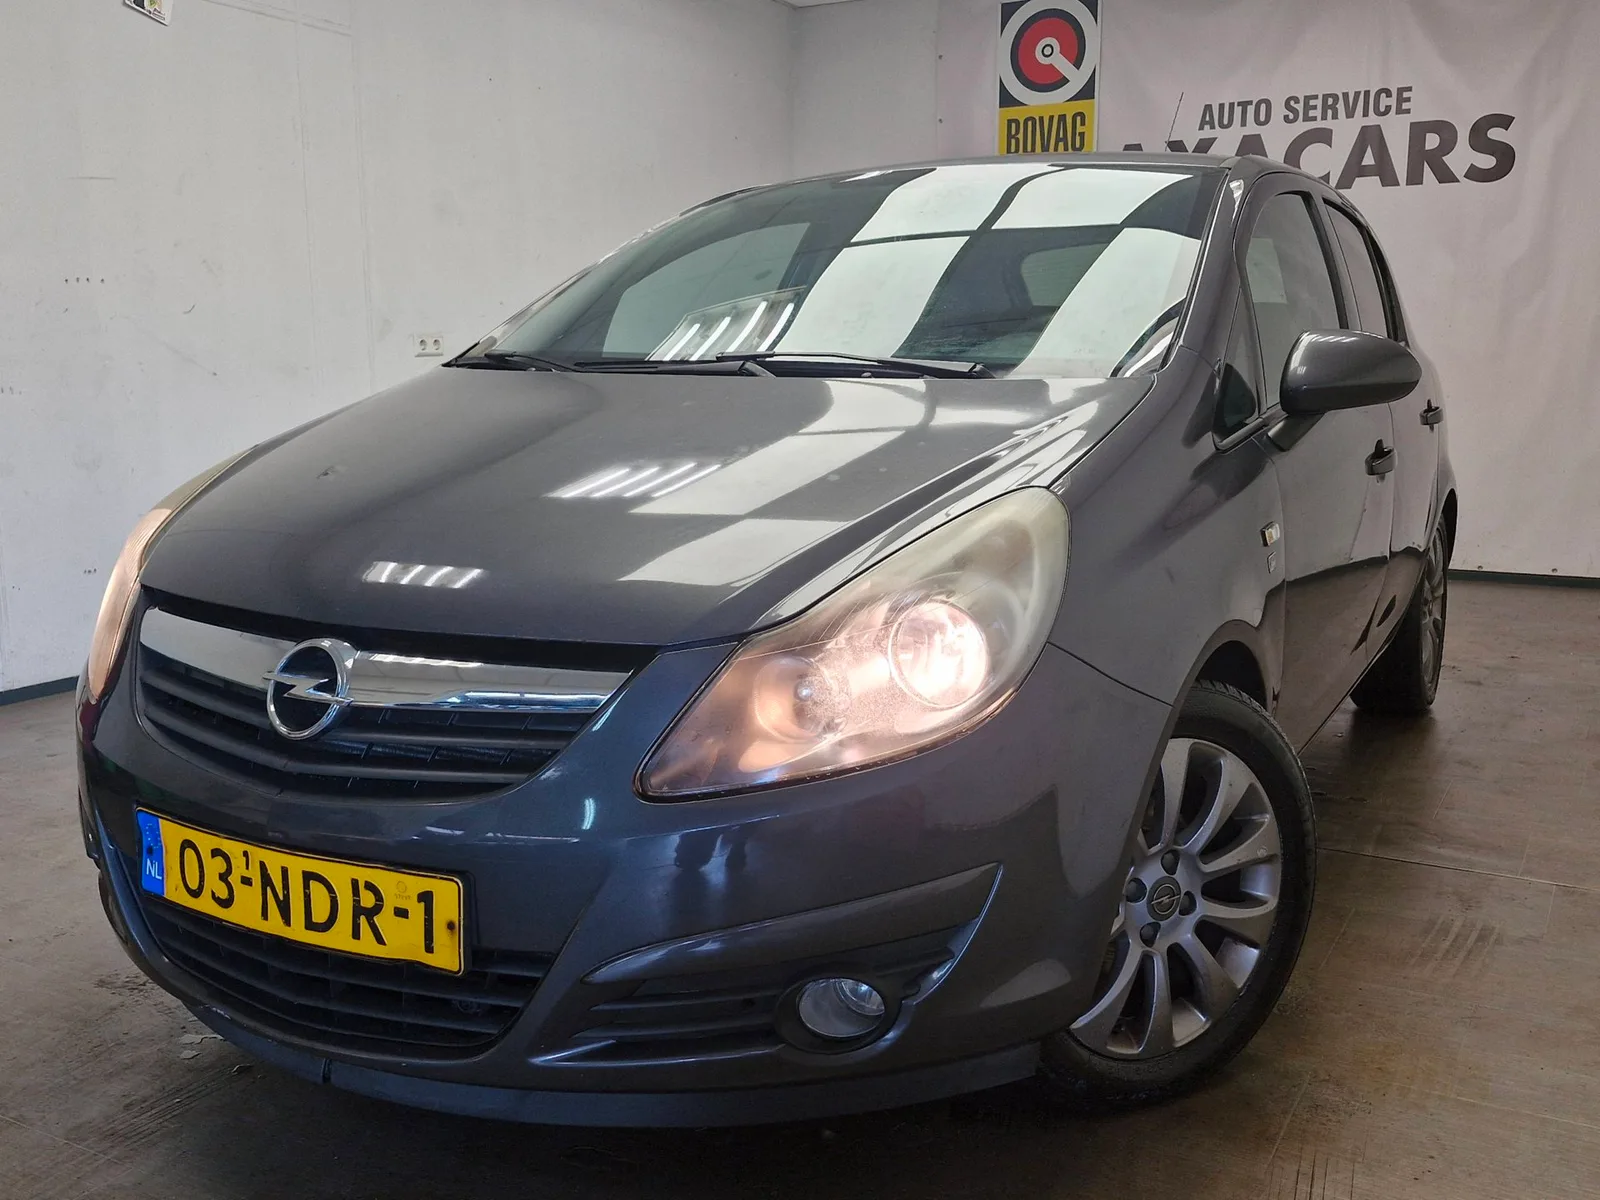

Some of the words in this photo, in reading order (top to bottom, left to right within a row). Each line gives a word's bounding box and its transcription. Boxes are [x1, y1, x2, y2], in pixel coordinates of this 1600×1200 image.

[1198, 98, 1272, 131] AUTO
[1283, 86, 1413, 124] SERVICE
[1006, 111, 1087, 154] BOVAG
[1122, 113, 1516, 189] CARS
[146, 858, 162, 880] NL
